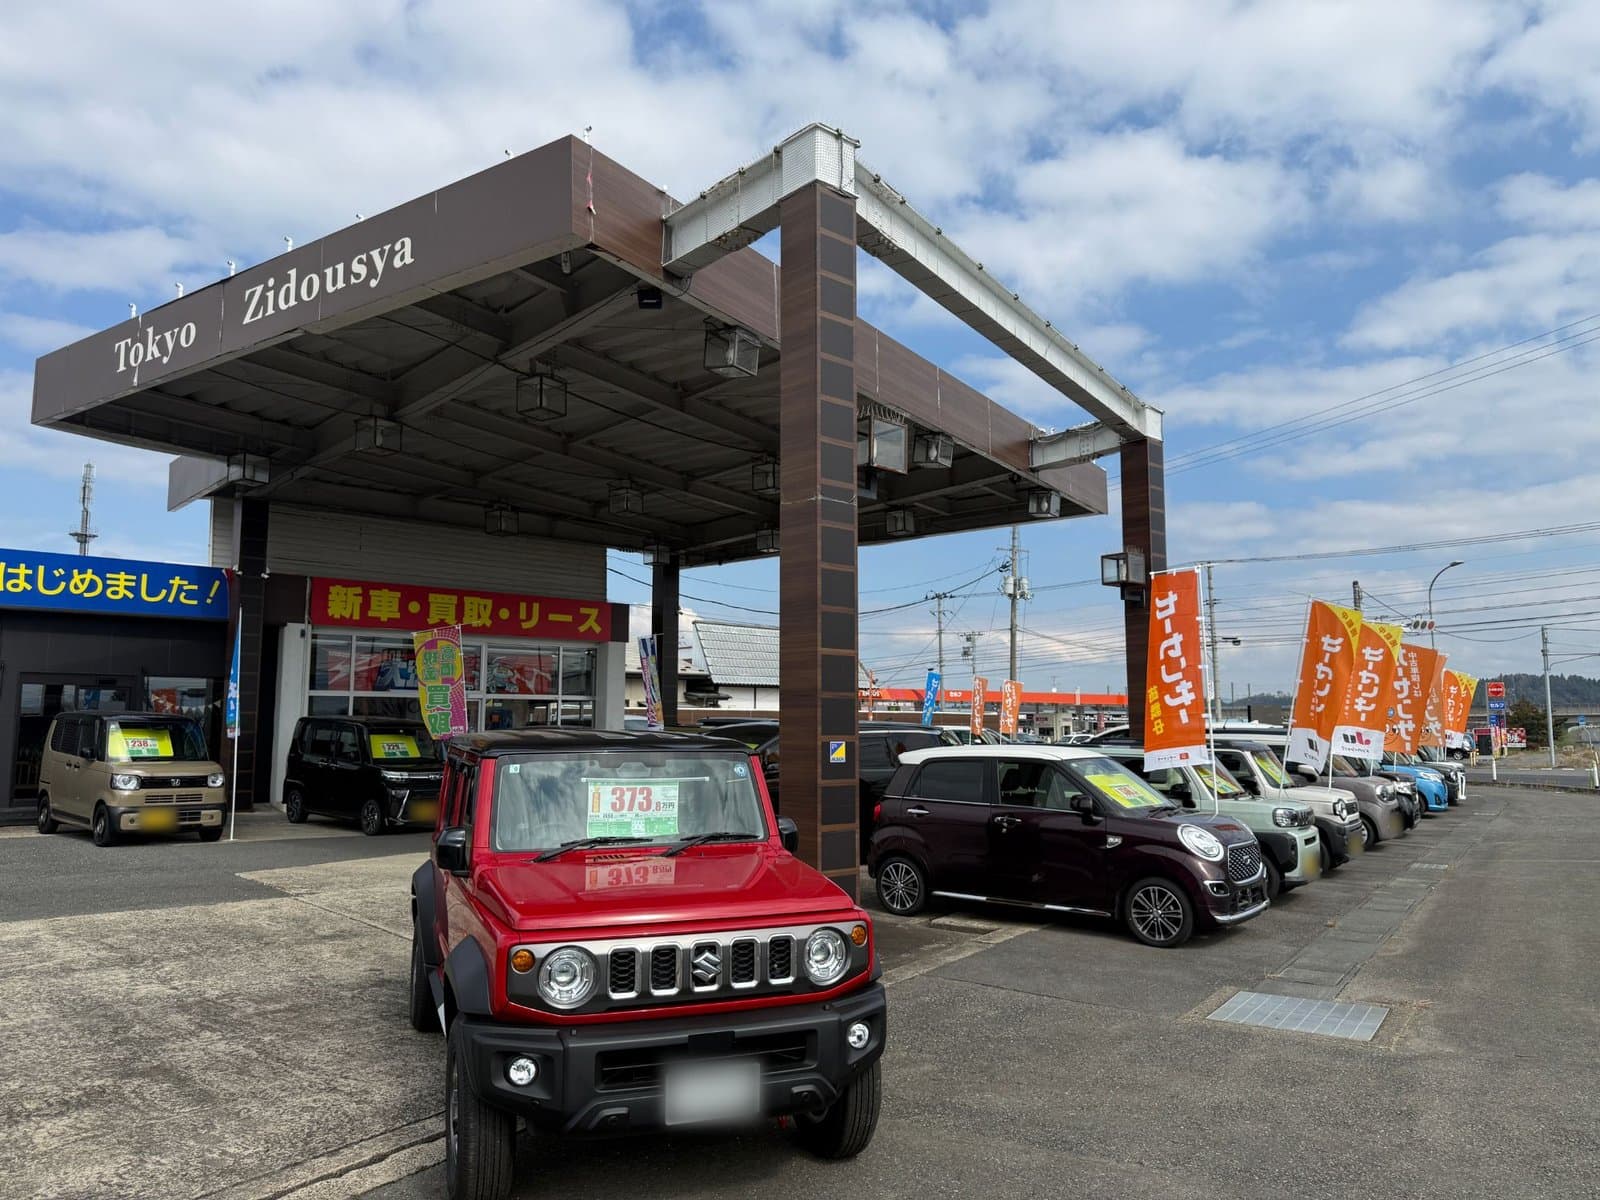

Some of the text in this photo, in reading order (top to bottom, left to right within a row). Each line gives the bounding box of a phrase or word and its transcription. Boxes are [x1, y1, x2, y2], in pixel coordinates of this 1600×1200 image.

[114, 236, 415, 373] Tokyo Zidousya
[327, 584, 602, 634] 新車・買取・リース
